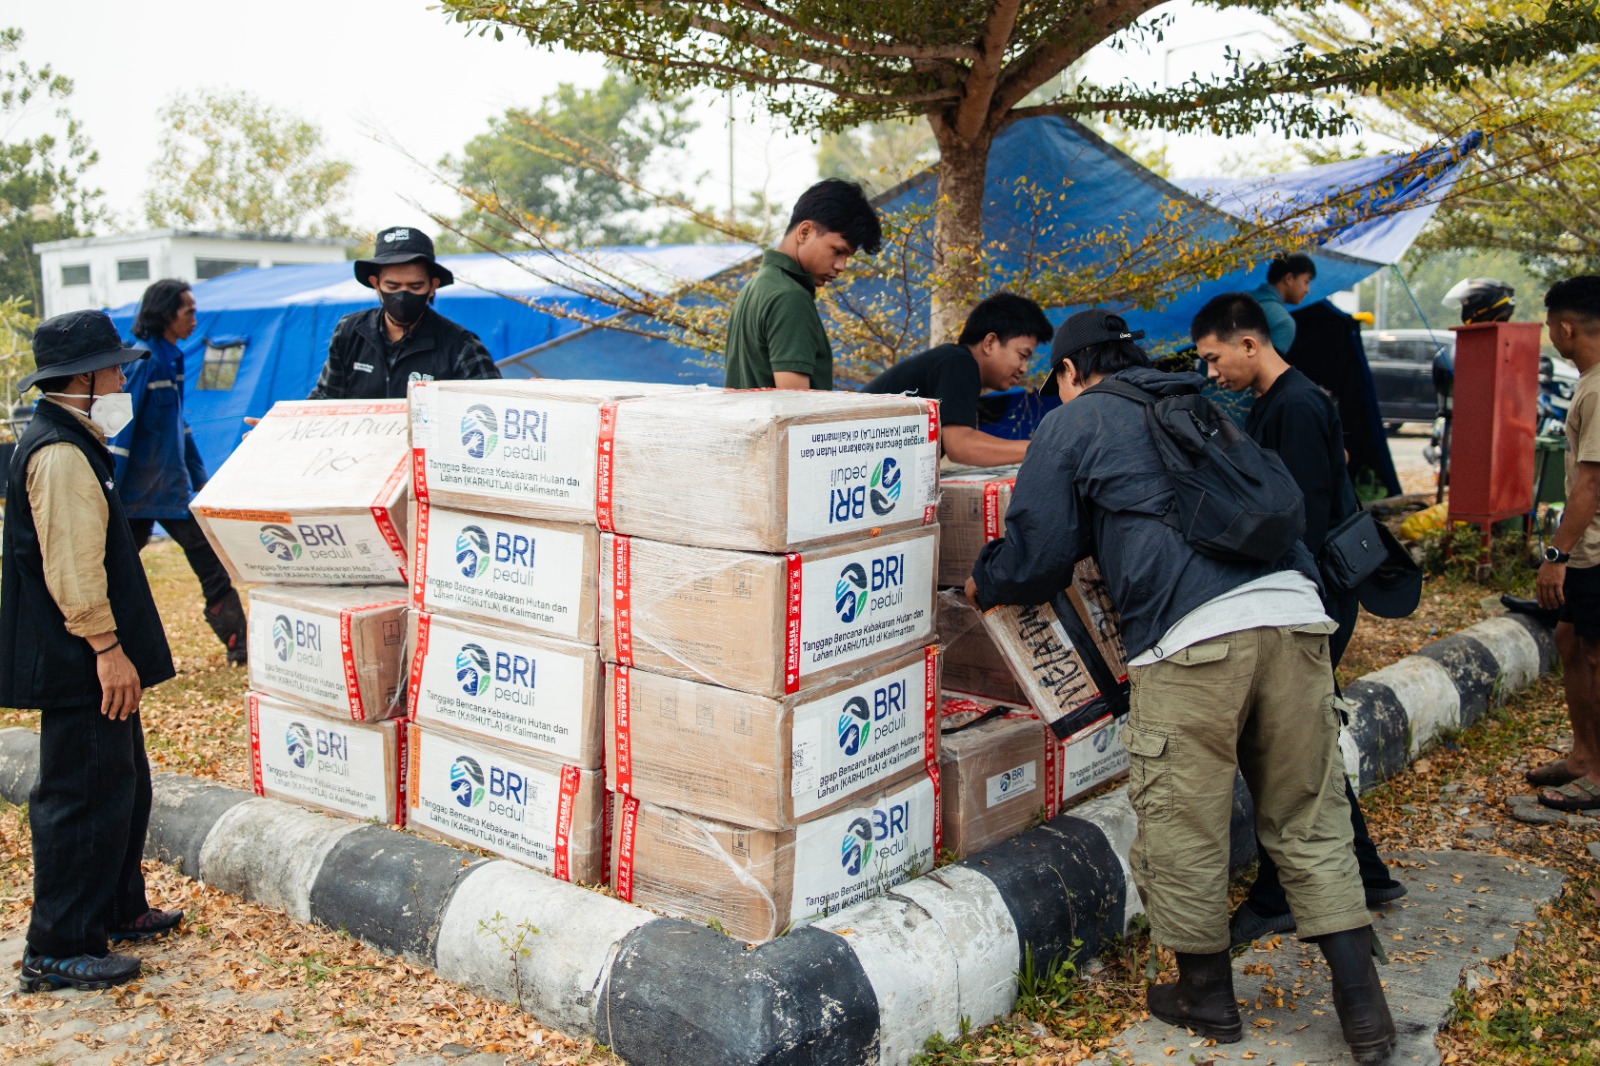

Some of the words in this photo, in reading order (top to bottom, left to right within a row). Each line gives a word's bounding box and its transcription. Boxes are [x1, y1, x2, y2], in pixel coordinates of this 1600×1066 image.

[504, 408, 548, 443] BRI
[812, 431, 851, 443] Kalimantan
[852, 430, 858, 439] di
[902, 424, 920, 434] Lahan
[504, 445, 547, 462] peduli
[800, 449, 814, 458] dan
[816, 446, 836, 457] Hutan
[838, 442, 874, 454] Kebakaran
[876, 439, 902, 450] Bencana
[429, 460, 460, 474] Tanggap
[462, 463, 494, 476] Bencana
[496, 468, 538, 482] Kebakaran
[540, 474, 564, 486] Hutan
[440, 474, 462, 485] Lahan
[514, 483, 522, 492] di
[523, 484, 570, 498] Kalimantan
[602, 454, 610, 503] FRAGILE
[830, 461, 868, 487] peduli
[829, 485, 866, 524] BRI
[297, 524, 346, 546] BRI
[494, 532, 536, 568] BRI
[310, 548, 352, 561] peduli
[415, 542, 423, 584] FRAGILE
[616, 537, 624, 586] FRAGILE
[492, 567, 535, 587] peduli
[871, 554, 904, 592] BRI
[426, 575, 454, 591] Tanggap
[454, 581, 484, 596] Bencana
[484, 588, 525, 604] Kebakaran
[526, 596, 550, 610] Hutan
[552, 602, 568, 614] dan
[433, 588, 454, 601] Lahan
[502, 605, 510, 614] di
[510, 606, 554, 624] Kalimantan
[870, 588, 903, 616] peduli
[296, 620, 322, 652] BRI
[787, 620, 796, 670] FRAGILE
[802, 636, 832, 652] Tanggap
[834, 628, 862, 643] Bencana
[864, 618, 895, 634] Kebakaran
[896, 614, 912, 624] Hutan
[913, 609, 924, 620] dan
[812, 650, 834, 662] Lahan
[834, 636, 875, 658] (KARHUTLA)
[876, 632, 882, 643] di
[883, 624, 915, 640] Kalimantan
[296, 651, 323, 668] peduli
[495, 651, 536, 690] BRI
[311, 686, 339, 700] Kalimantan
[320, 678, 335, 688] Hutan
[494, 686, 535, 707] peduli
[426, 690, 455, 708] Tanggap
[456, 698, 488, 714] Bencana
[488, 706, 528, 724] Kebakaran
[528, 716, 552, 732] Hutan
[553, 723, 568, 736] dan
[620, 678, 628, 728] FRAGILE
[874, 679, 906, 722] BRI
[436, 706, 456, 719] Lahan
[457, 710, 503, 732] (KARHUTLA)
[504, 724, 512, 733] di
[512, 725, 556, 745] Kalimantan
[874, 716, 906, 744] peduli
[316, 728, 348, 762] BRI
[838, 760, 866, 778] Bencana
[868, 742, 900, 764] Kebakaran
[900, 735, 918, 748] Hutan
[918, 732, 926, 740] da
[266, 764, 288, 778] Tanggap
[314, 776, 344, 792] Kebakaran
[346, 786, 364, 798] Hutan
[364, 793, 376, 802] dan
[318, 756, 350, 777] peduli
[817, 782, 838, 800] Lahan
[882, 760, 888, 770] di
[888, 746, 920, 766] Kalimantan
[1012, 766, 1024, 780] BRI
[274, 776, 291, 788] Lahan
[335, 794, 368, 808] Kalimantan
[490, 766, 528, 806] BRI
[420, 796, 448, 816] Tanggap
[449, 808, 480, 827] Bencana
[480, 820, 520, 840] Kebakaran
[520, 832, 544, 850] Hutan
[546, 840, 555, 854] da
[488, 800, 525, 823] pedul
[558, 792, 568, 836] FRAGILE
[430, 812, 450, 828] Lahan
[451, 820, 496, 846] (KARHUTLA)
[497, 835, 504, 846] di
[506, 839, 548, 862] Kalimantan
[625, 814, 634, 858] FRAGILE
[920, 846, 932, 858] dan
